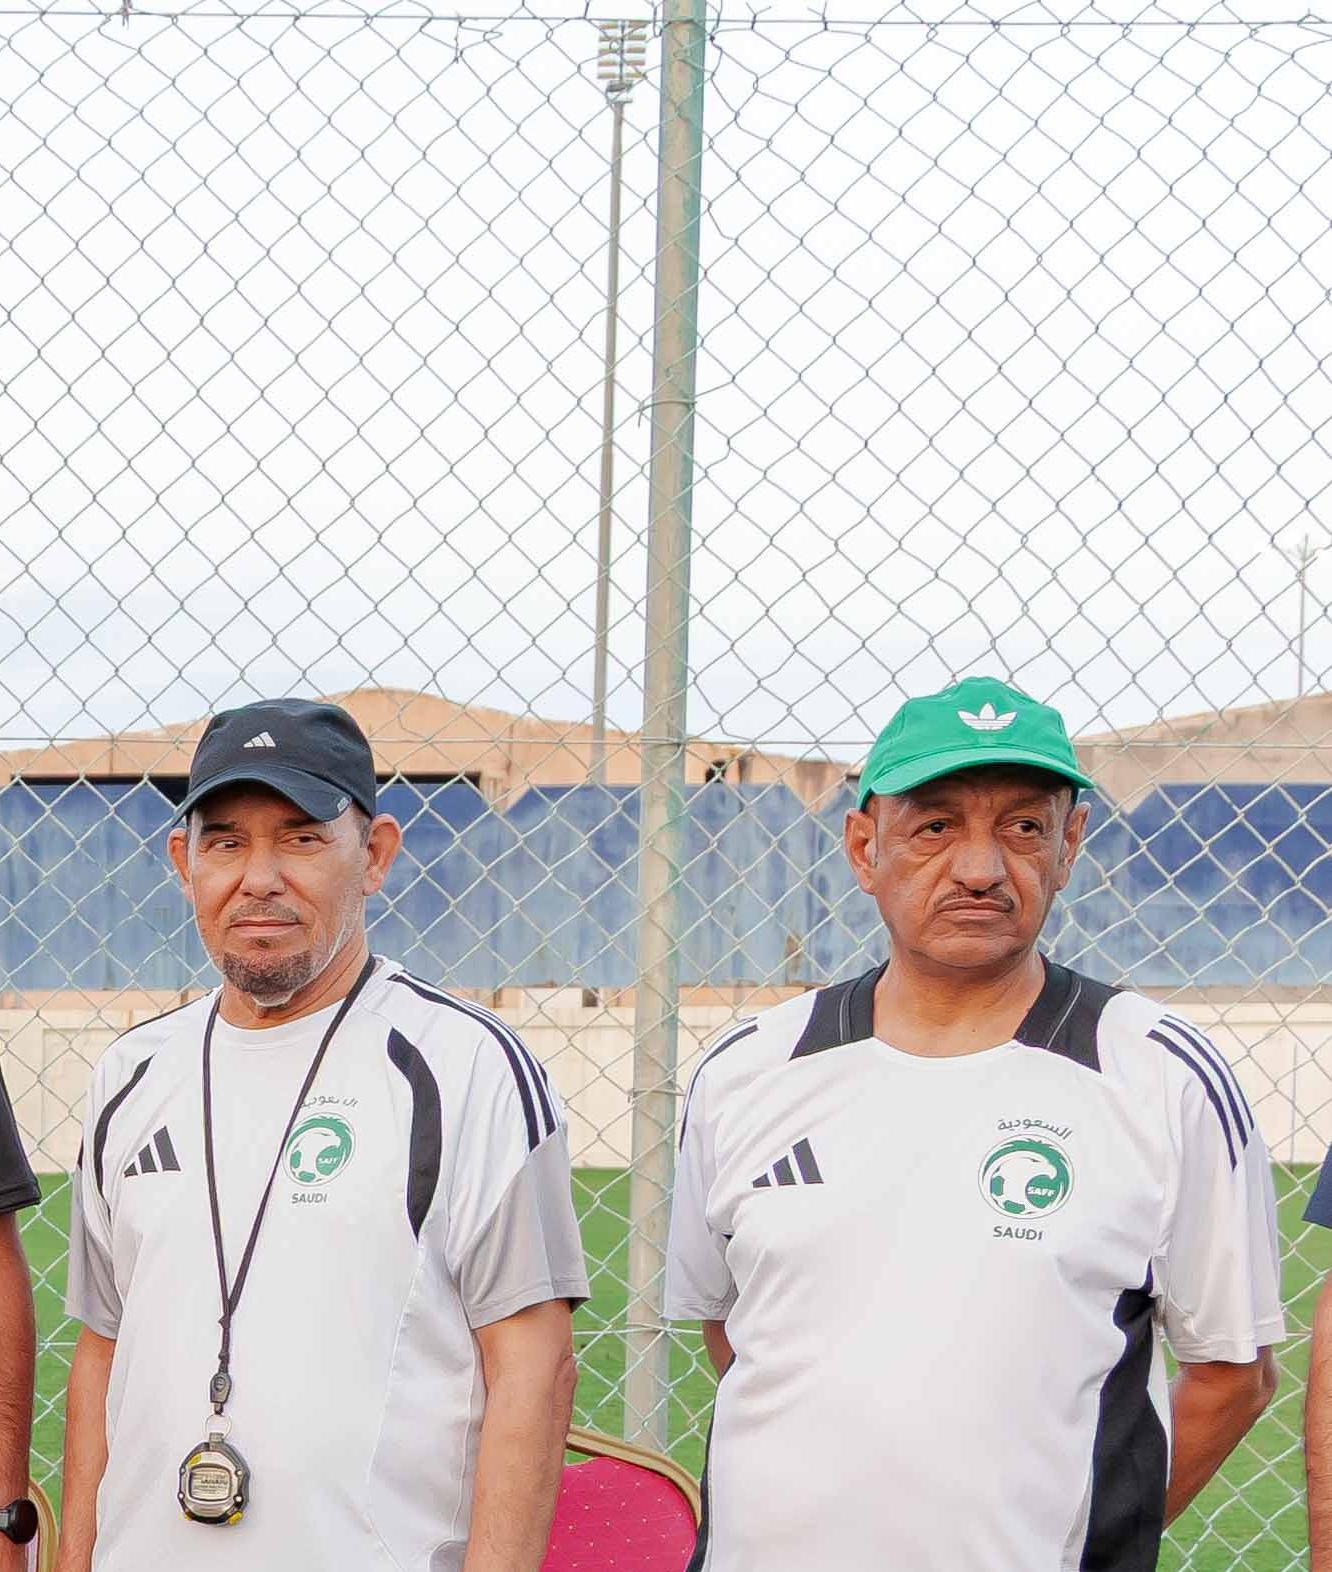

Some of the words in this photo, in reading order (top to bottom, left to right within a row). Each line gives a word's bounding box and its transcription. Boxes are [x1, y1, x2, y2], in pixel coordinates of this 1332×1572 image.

[997, 1118, 1073, 1140] السعودية
[291, 1193, 328, 1204] SAUDI
[992, 1225, 1043, 1241] SAUDI
